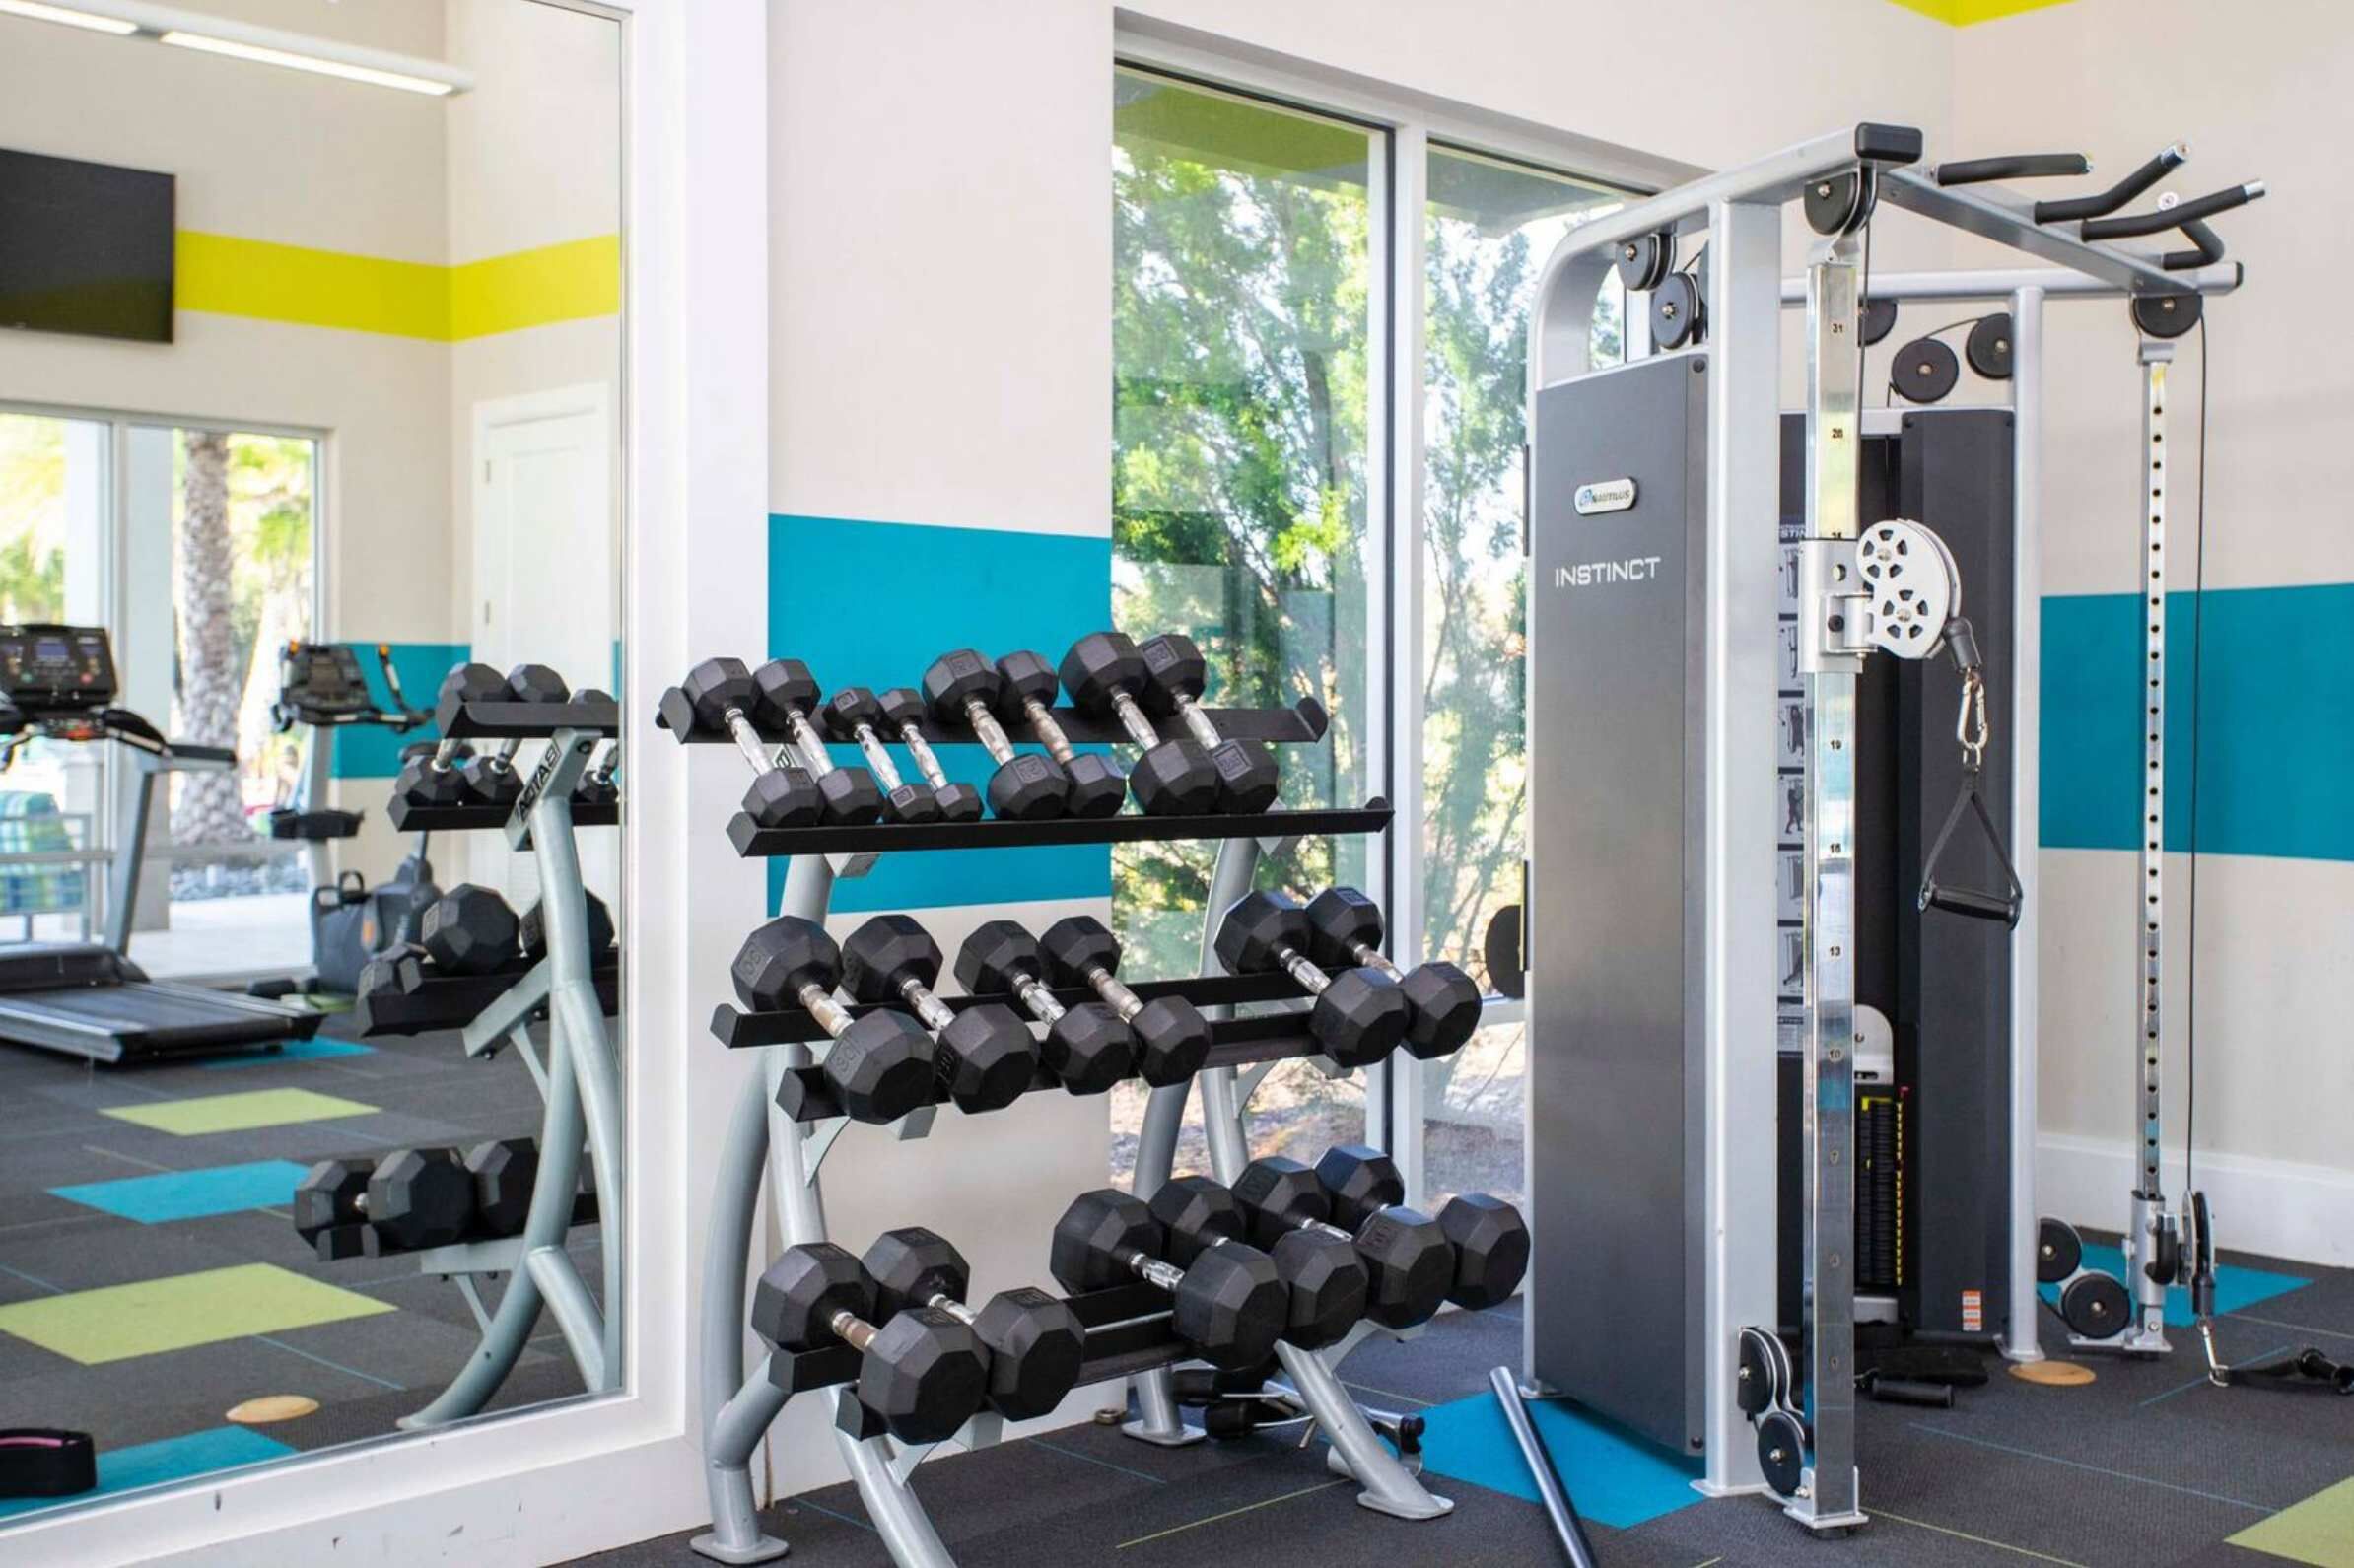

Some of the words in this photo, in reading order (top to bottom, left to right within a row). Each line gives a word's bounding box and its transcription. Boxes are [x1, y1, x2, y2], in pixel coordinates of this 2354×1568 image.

[1833, 324, 1843, 333] 31
[1556, 557, 1661, 588] INSTINCT
[1831, 740, 1841, 750] 19
[1830, 946, 1841, 956] 13
[1830, 1049, 1841, 1058] 10
